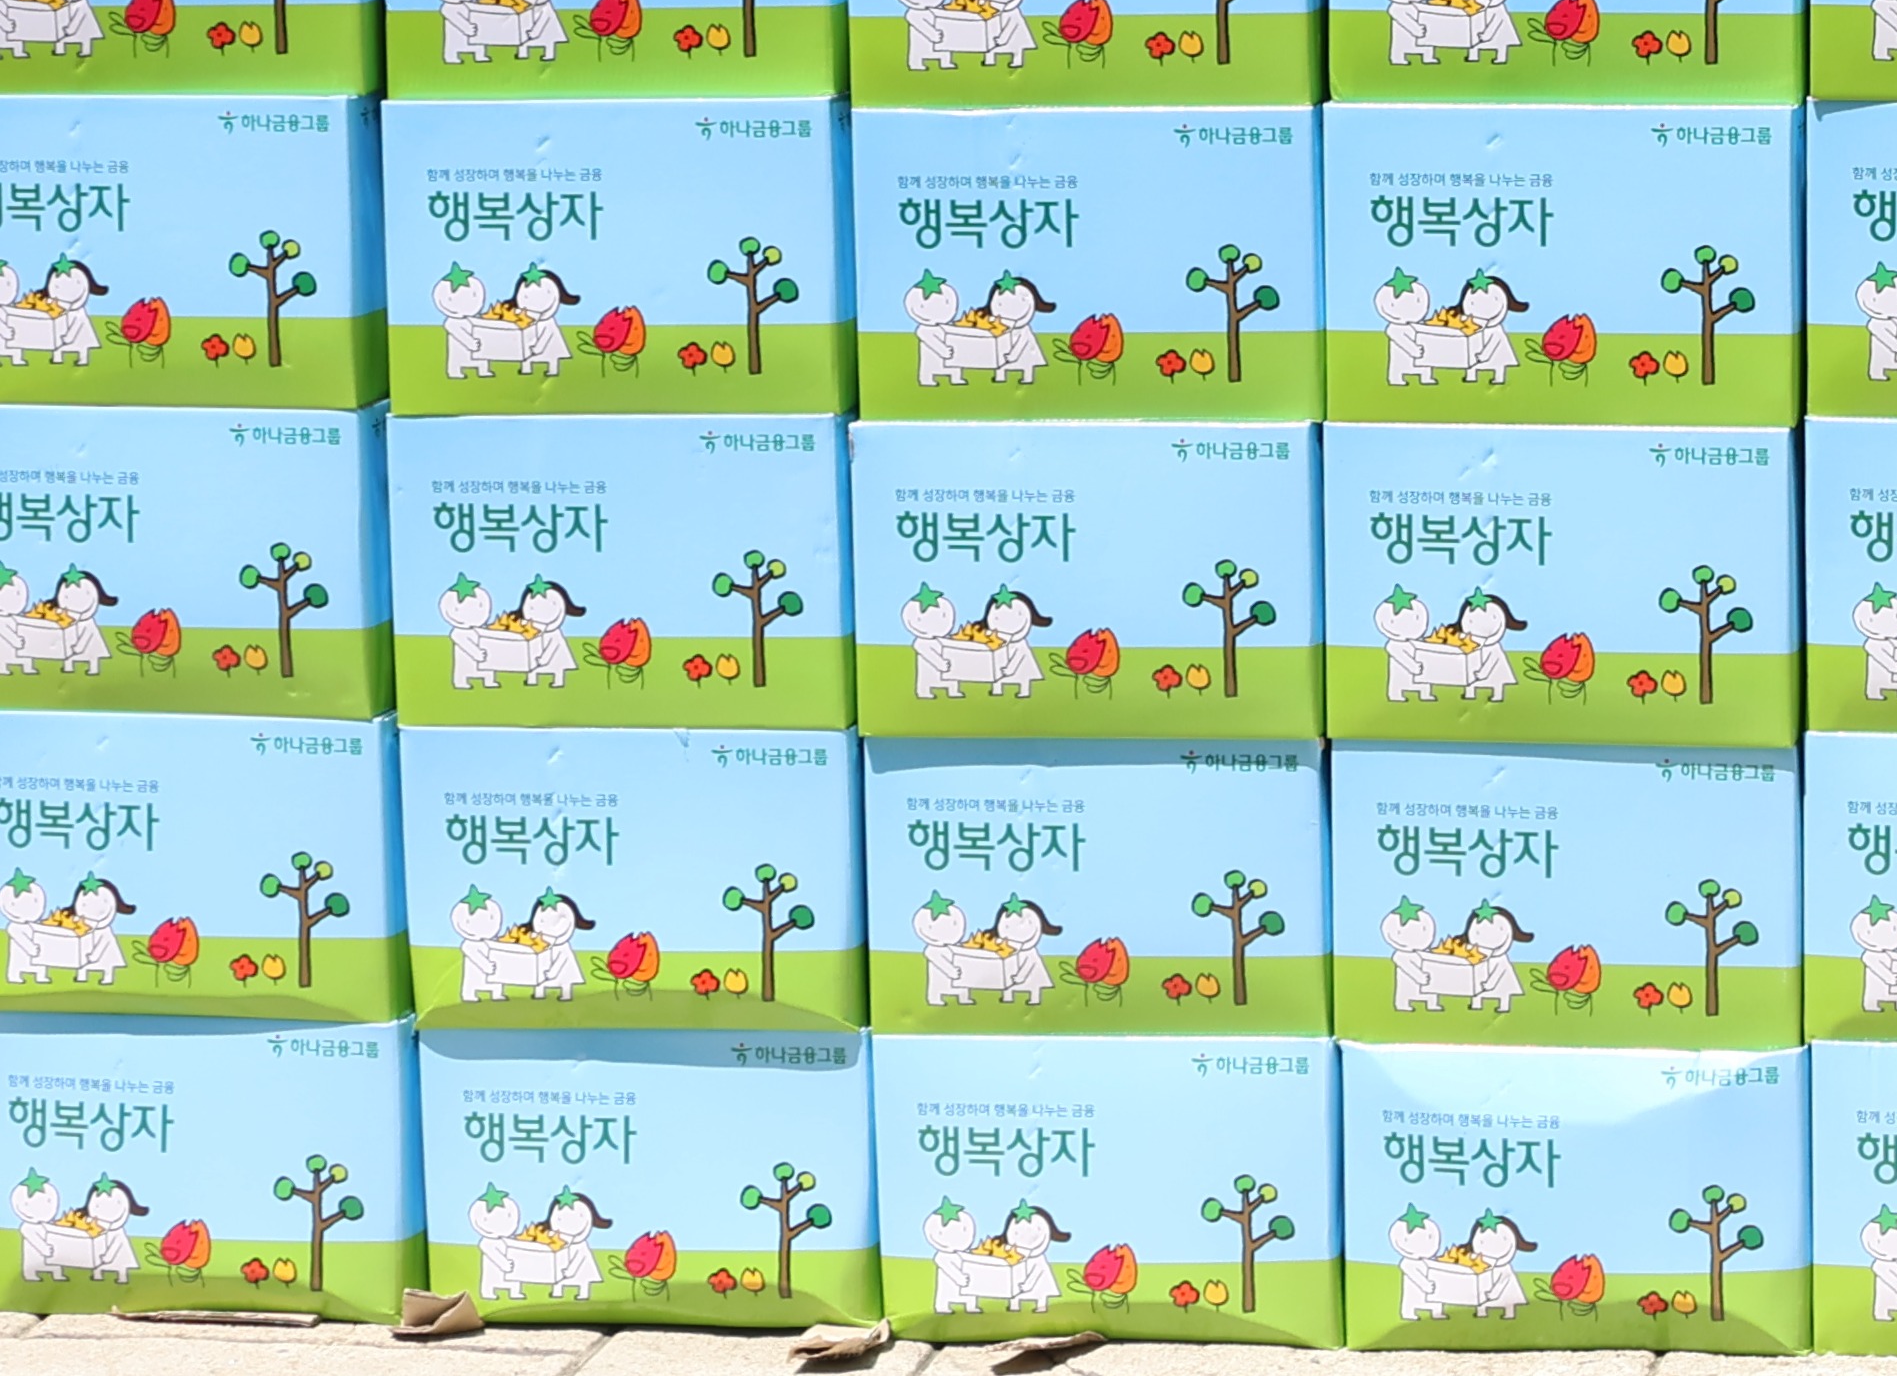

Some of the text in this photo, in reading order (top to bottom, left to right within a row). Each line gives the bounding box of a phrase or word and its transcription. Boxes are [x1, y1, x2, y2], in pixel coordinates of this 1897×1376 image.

[719, 119, 813, 139] 하나금융그룹
[1198, 126, 1293, 146] 하나금융그룹
[1369, 172, 1553, 188] 함께 성장하며 행복을 나누는 금융
[427, 190, 604, 242] 행복상자
[898, 197, 1080, 250] 행복상자
[1370, 194, 1554, 248] 행복상자
[251, 426, 341, 446] 하나금융그룹
[1674, 446, 1770, 467] 하나금융그룹
[433, 501, 609, 554] 행복상자
[896, 510, 1077, 563] 행복상자
[1370, 511, 1553, 566] 행복상자
[735, 747, 829, 767] 하나금융그룹
[1847, 800, 1872, 815] 함께
[445, 813, 620, 867] 행복상자
[907, 818, 1086, 873] 행복상자
[1377, 823, 1559, 879] 행복상자
[1215, 1055, 1310, 1075] 하나금융그룹
[8, 1096, 174, 1154] 행복상자
[464, 1111, 637, 1165] 행복상자
[918, 1124, 1096, 1178] 행복상자
[1383, 1131, 1561, 1189] 행복상자
